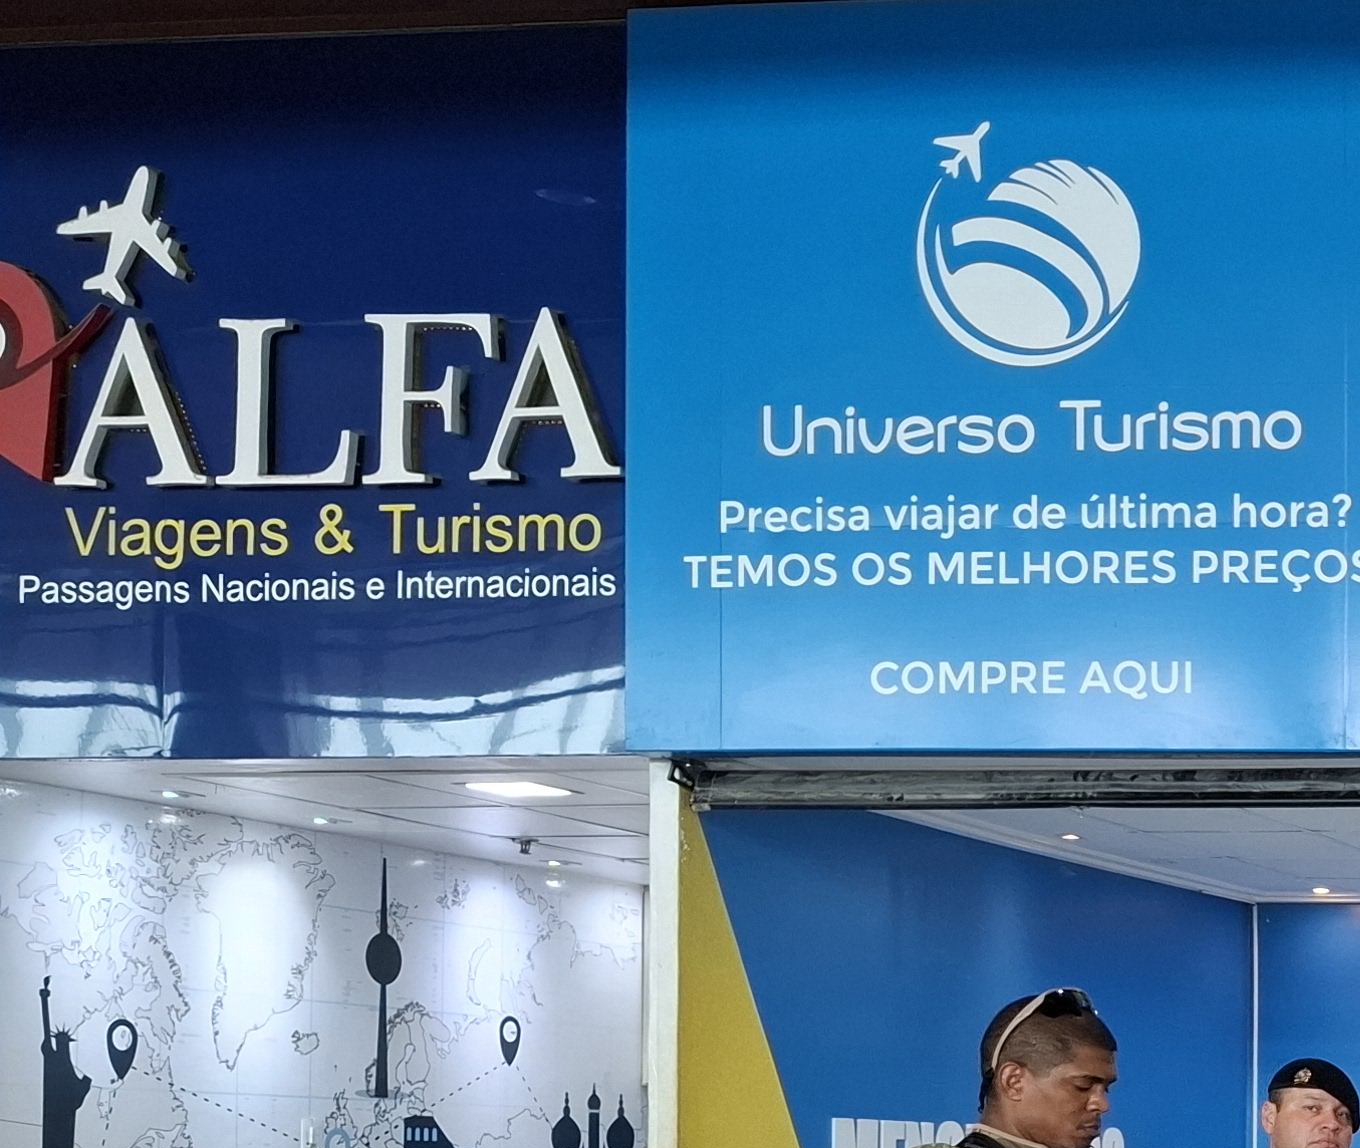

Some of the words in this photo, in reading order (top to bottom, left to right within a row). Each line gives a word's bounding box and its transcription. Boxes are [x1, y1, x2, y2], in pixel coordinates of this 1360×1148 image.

[54, 307, 623, 487] ALFA
[762, 405, 1035, 456] Universo
[1060, 399, 1303, 452] Turismo
[64, 506, 289, 569] Viagens
[314, 504, 354, 555] &
[378, 503, 602, 554] Turismo
[719, 497, 871, 533] Precisa
[883, 497, 1000, 540] viajar
[1012, 495, 1066, 530] de
[1080, 493, 1218, 530] última
[1232, 493, 1353, 529] hora?
[18, 575, 190, 611] Passagens
[201, 572, 356, 603] Nacionais
[366, 576, 385, 600] e
[396, 567, 617, 599] Internacionais
[684, 553, 836, 589] TEMOS
[850, 552, 912, 587] OS
[926, 549, 1176, 585] MELHORES
[870, 661, 1067, 696] COMPRE
[1080, 659, 1193, 700] AQUI
